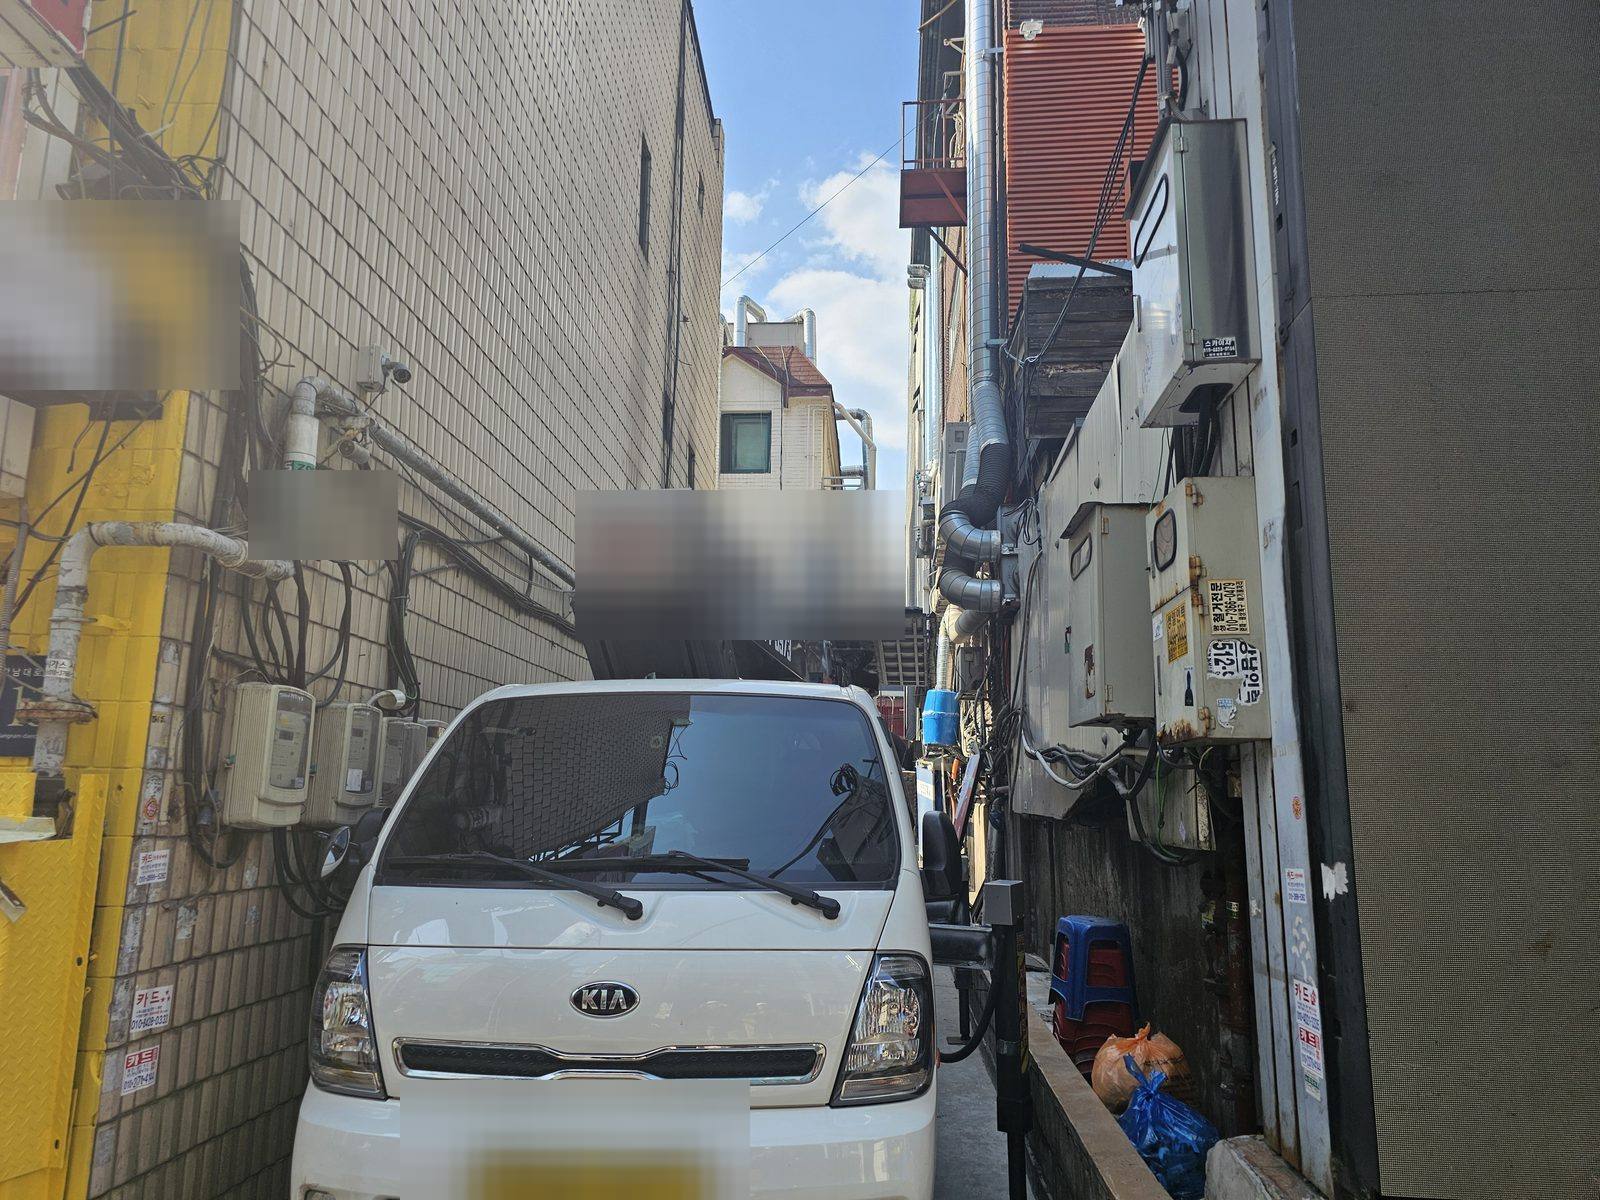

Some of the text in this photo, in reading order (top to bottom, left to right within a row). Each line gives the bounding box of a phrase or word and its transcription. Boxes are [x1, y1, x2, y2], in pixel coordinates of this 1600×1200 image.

[1211, 582, 1225, 622] 철거전문
[136, 991, 160, 1007] 카드
[581, 989, 628, 1010] KIA
[127, 1050, 153, 1068] 카드
